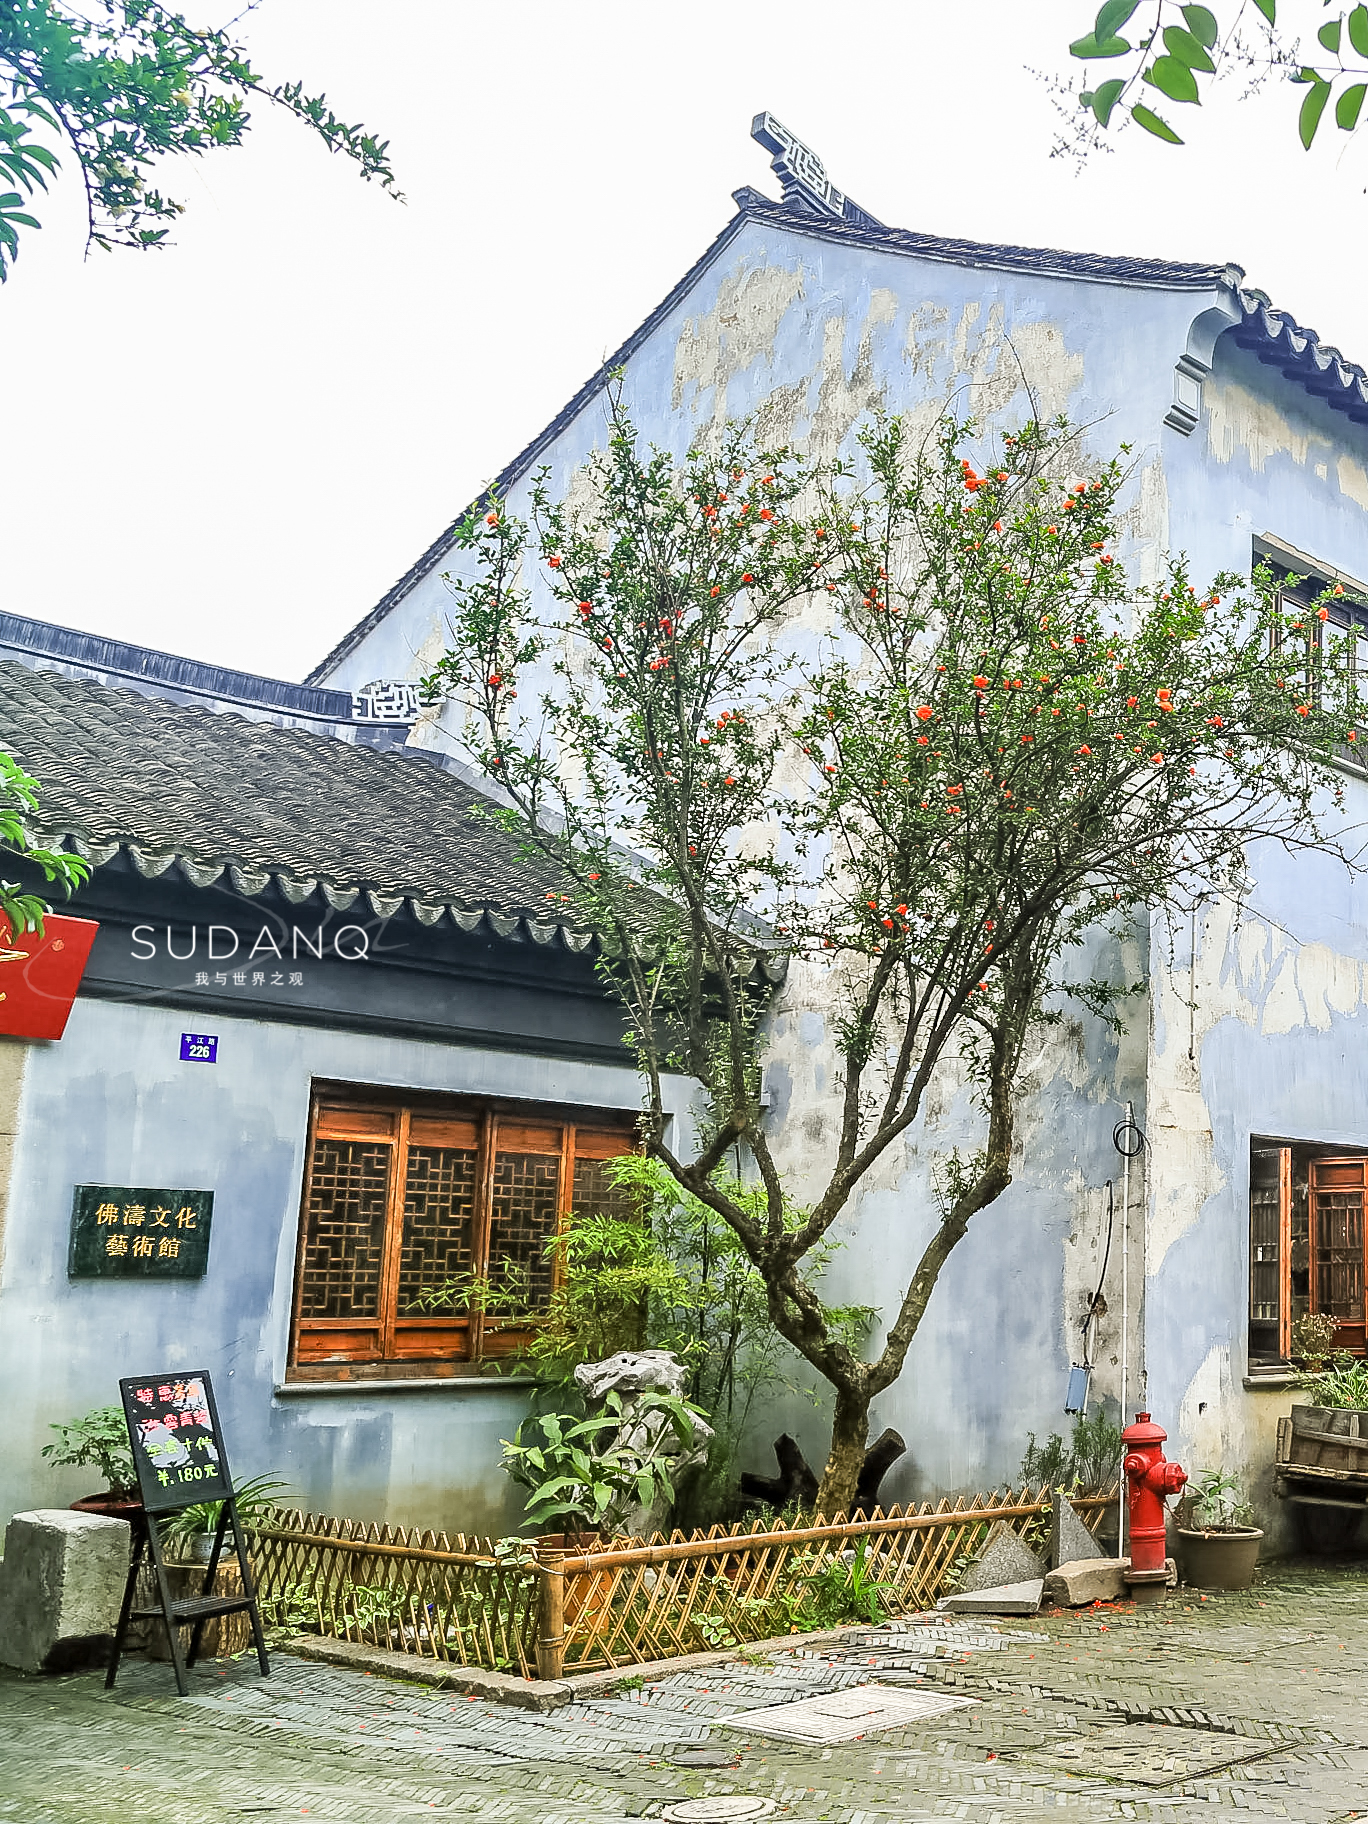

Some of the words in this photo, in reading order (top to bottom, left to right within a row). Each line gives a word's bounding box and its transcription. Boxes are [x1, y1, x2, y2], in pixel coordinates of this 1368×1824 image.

[188, 1044, 210, 1058] 226
[95, 1203, 197, 1229] 佛濤文化
[105, 1233, 182, 1258] 藝術館
